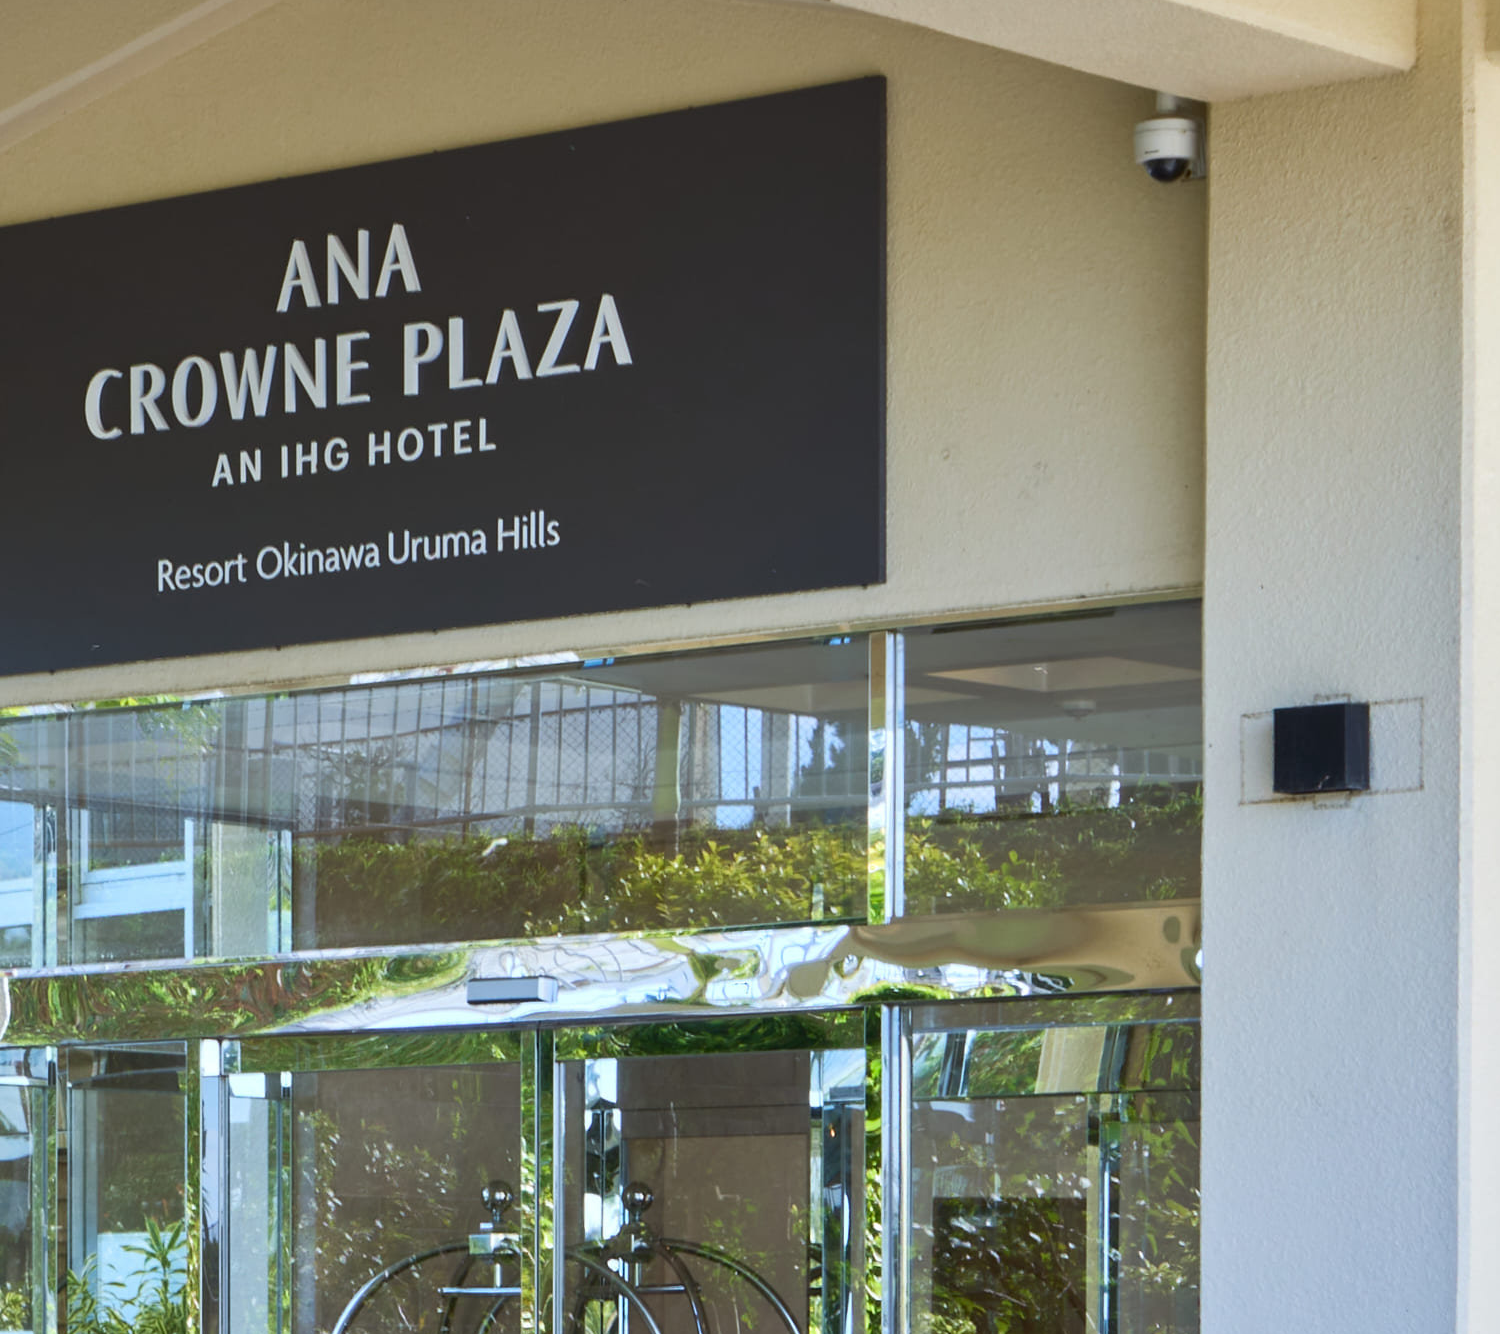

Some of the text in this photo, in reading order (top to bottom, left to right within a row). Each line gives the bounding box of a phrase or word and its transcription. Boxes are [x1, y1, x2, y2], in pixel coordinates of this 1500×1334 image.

[276, 223, 422, 313] ANA
[84, 293, 633, 440] CROWNE PLAZA
[211, 417, 497, 488] AN IHG HOTEL
[157, 509, 561, 593] Resort Okinawa Uruma Hills
